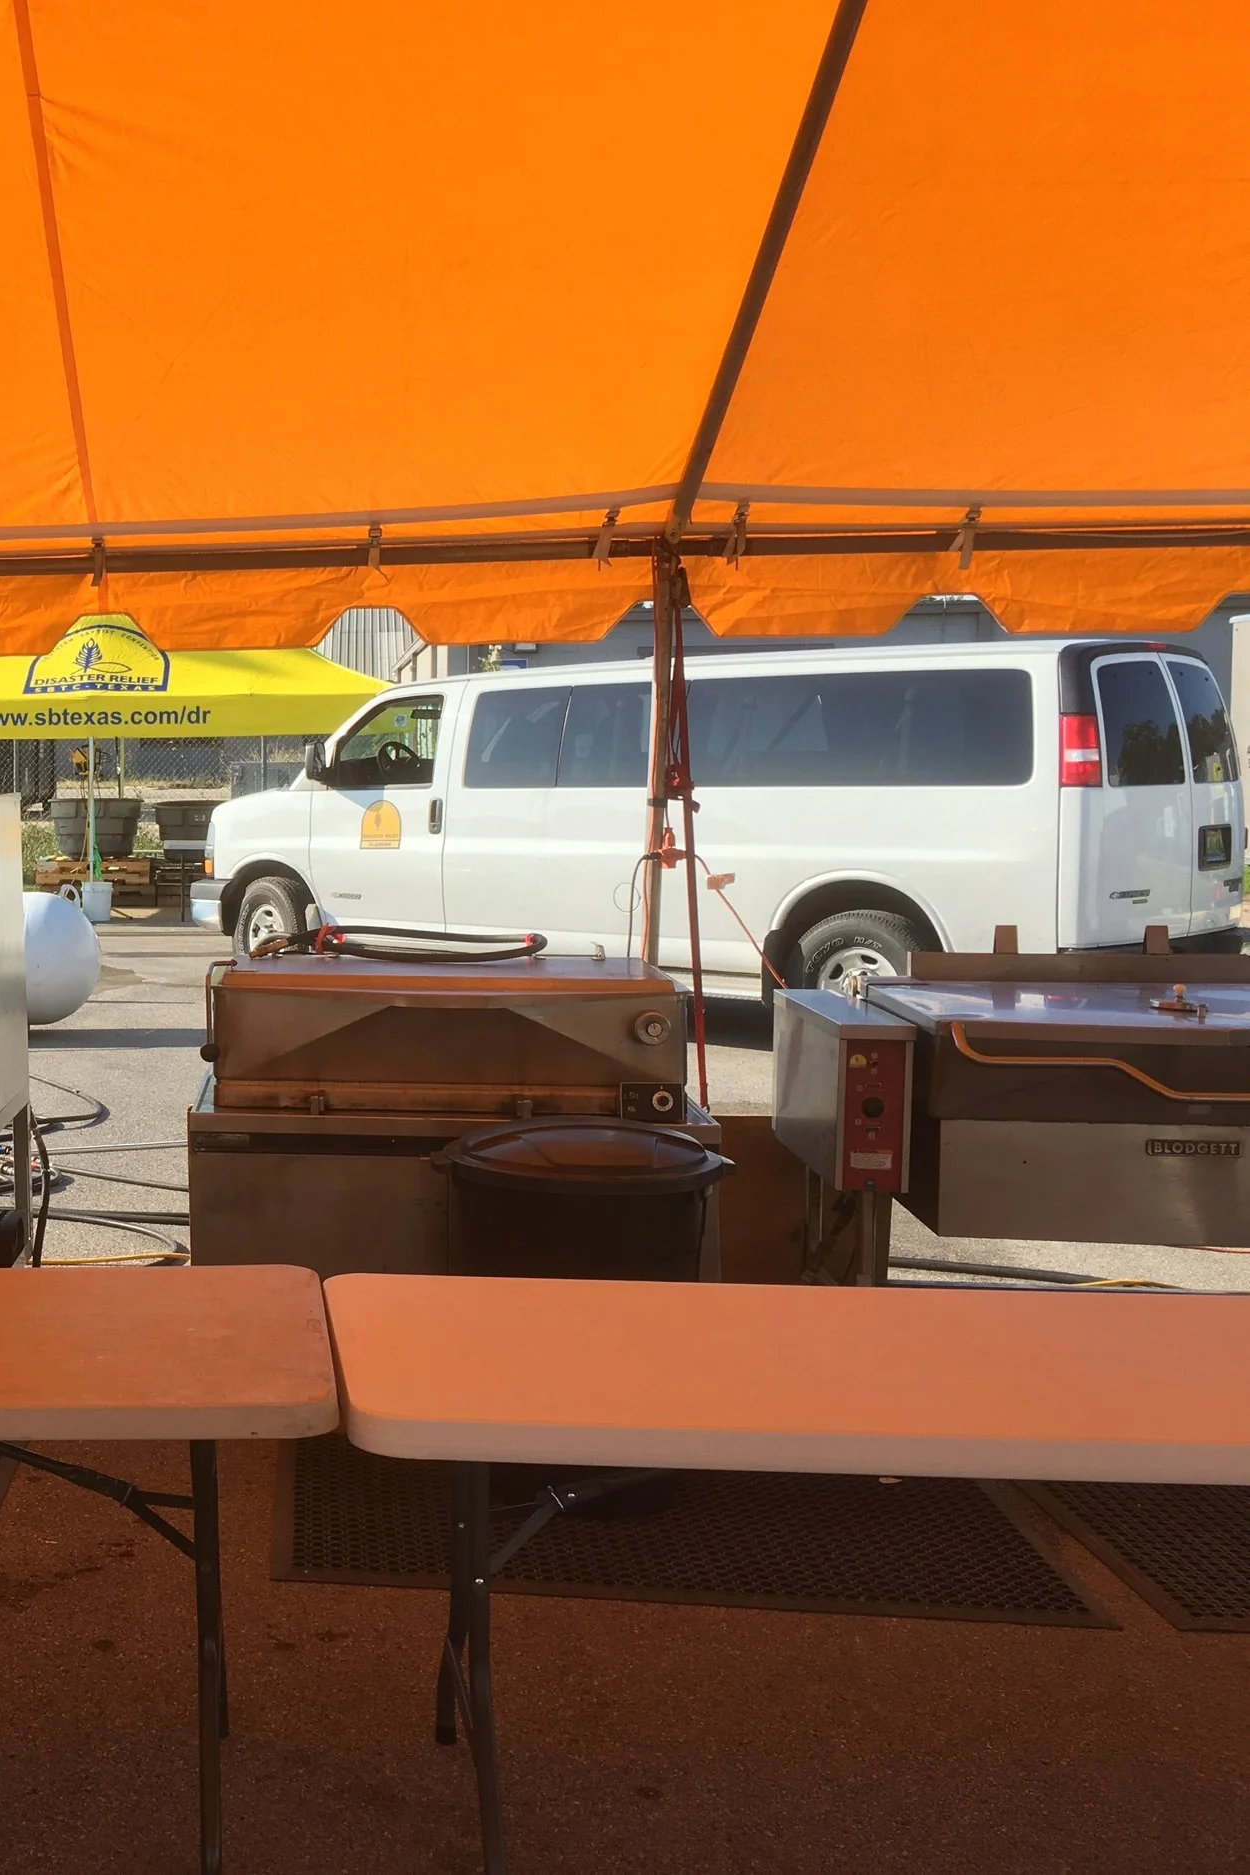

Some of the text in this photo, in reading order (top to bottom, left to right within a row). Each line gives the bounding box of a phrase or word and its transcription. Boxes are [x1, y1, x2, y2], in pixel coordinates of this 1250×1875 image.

[34, 673, 159, 686] DISASTER RELIEF
[1154, 1142, 1238, 1154] BLODGETT
